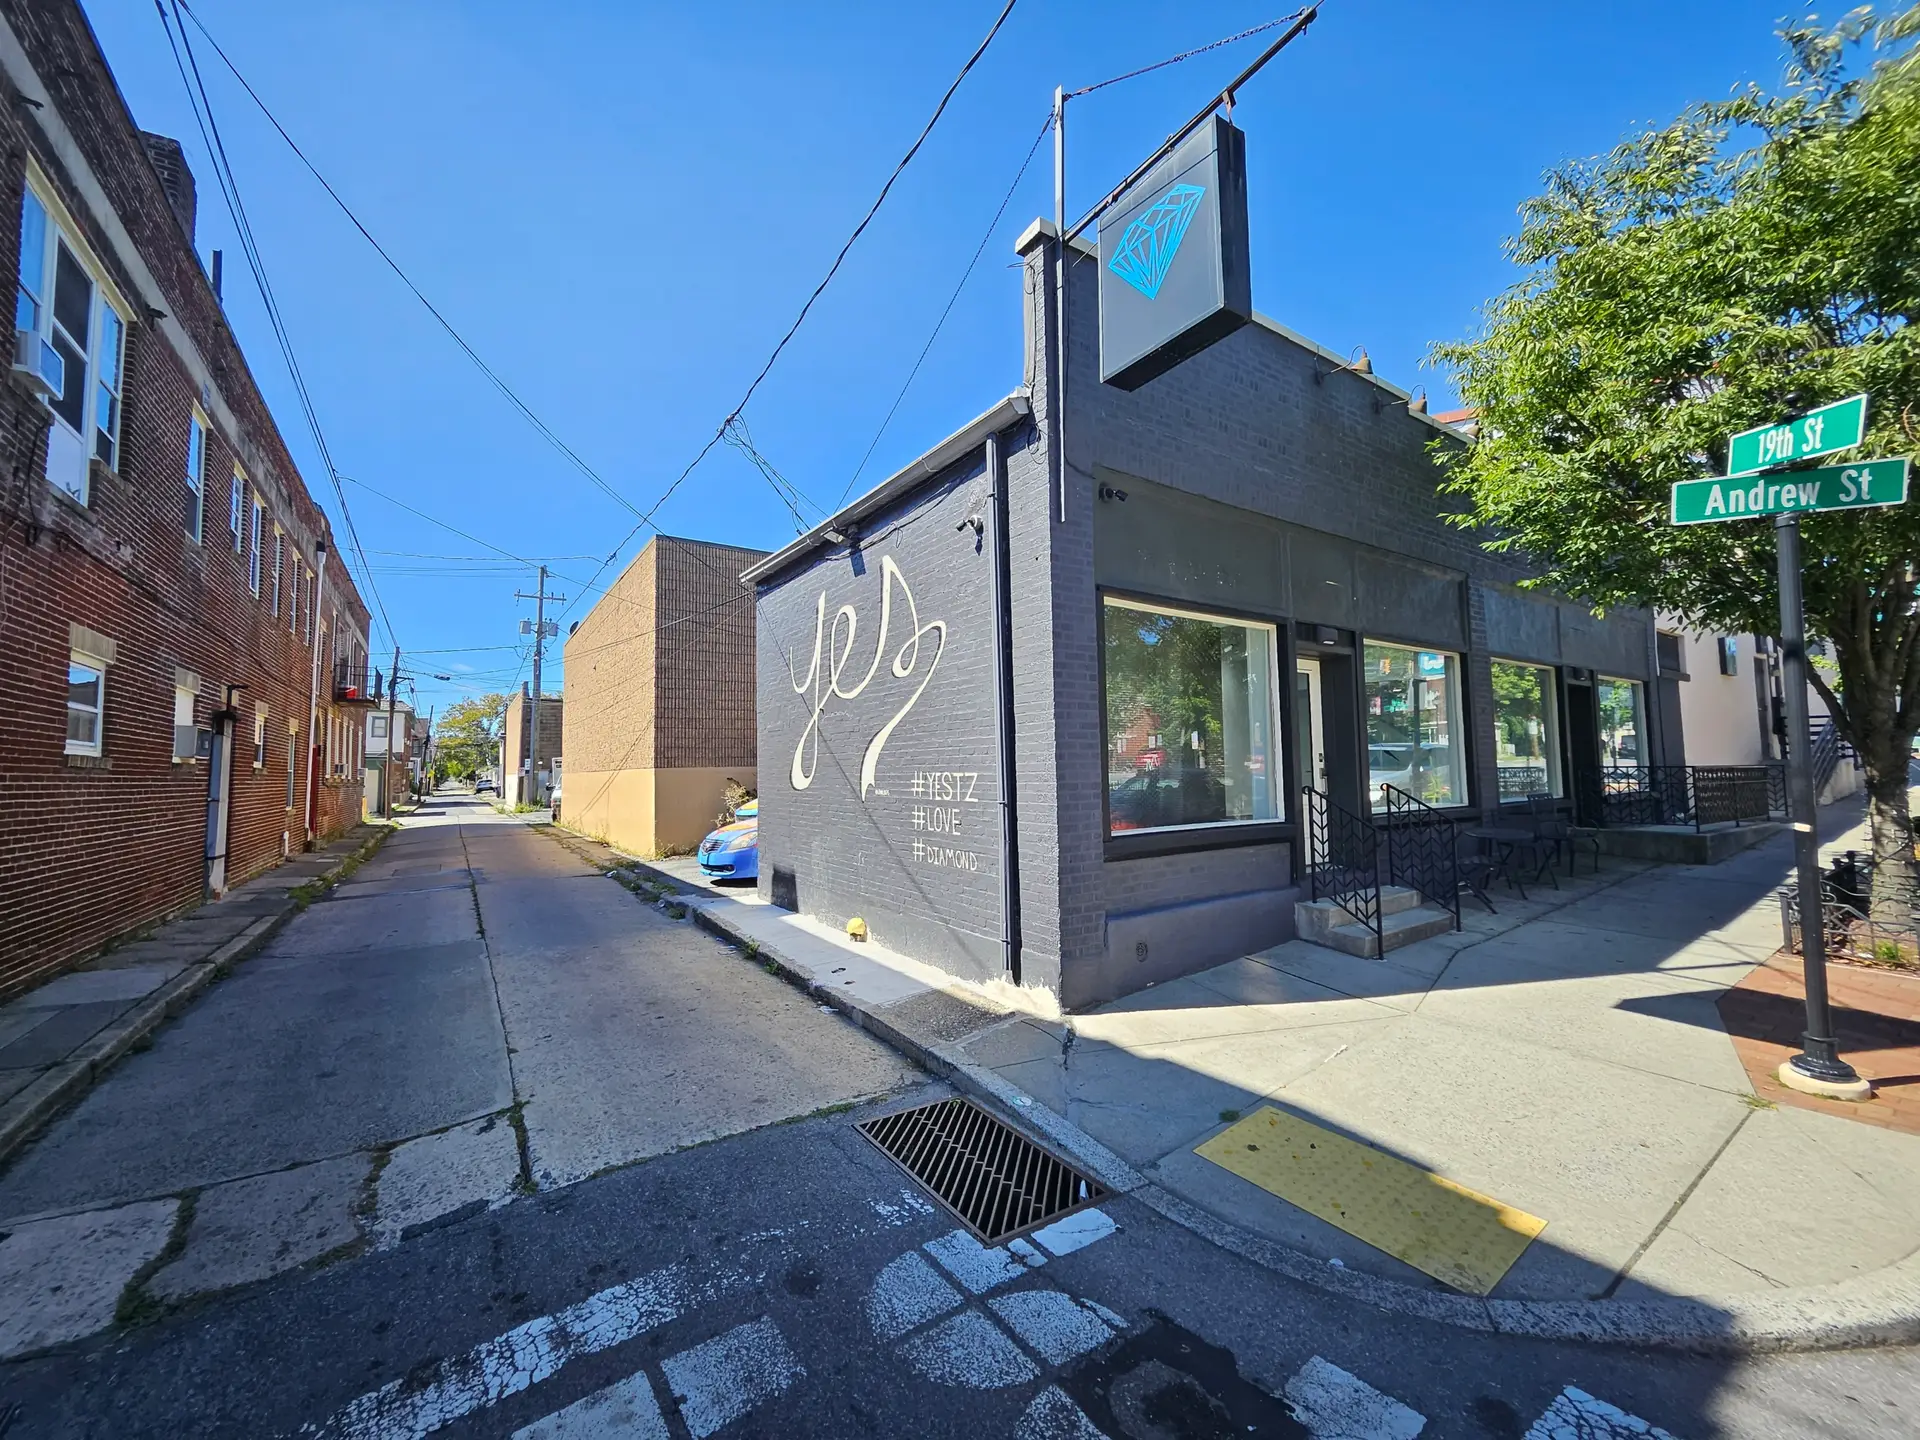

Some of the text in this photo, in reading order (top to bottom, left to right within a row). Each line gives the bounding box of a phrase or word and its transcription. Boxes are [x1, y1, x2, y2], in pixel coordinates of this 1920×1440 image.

[1758, 416, 1824, 463] 19th St
[1704, 468, 1873, 516] Andrew St
[910, 770, 979, 802] #YESTZ
[911, 805, 961, 835] #LOVE
[912, 838, 978, 871] #DIAMOND
